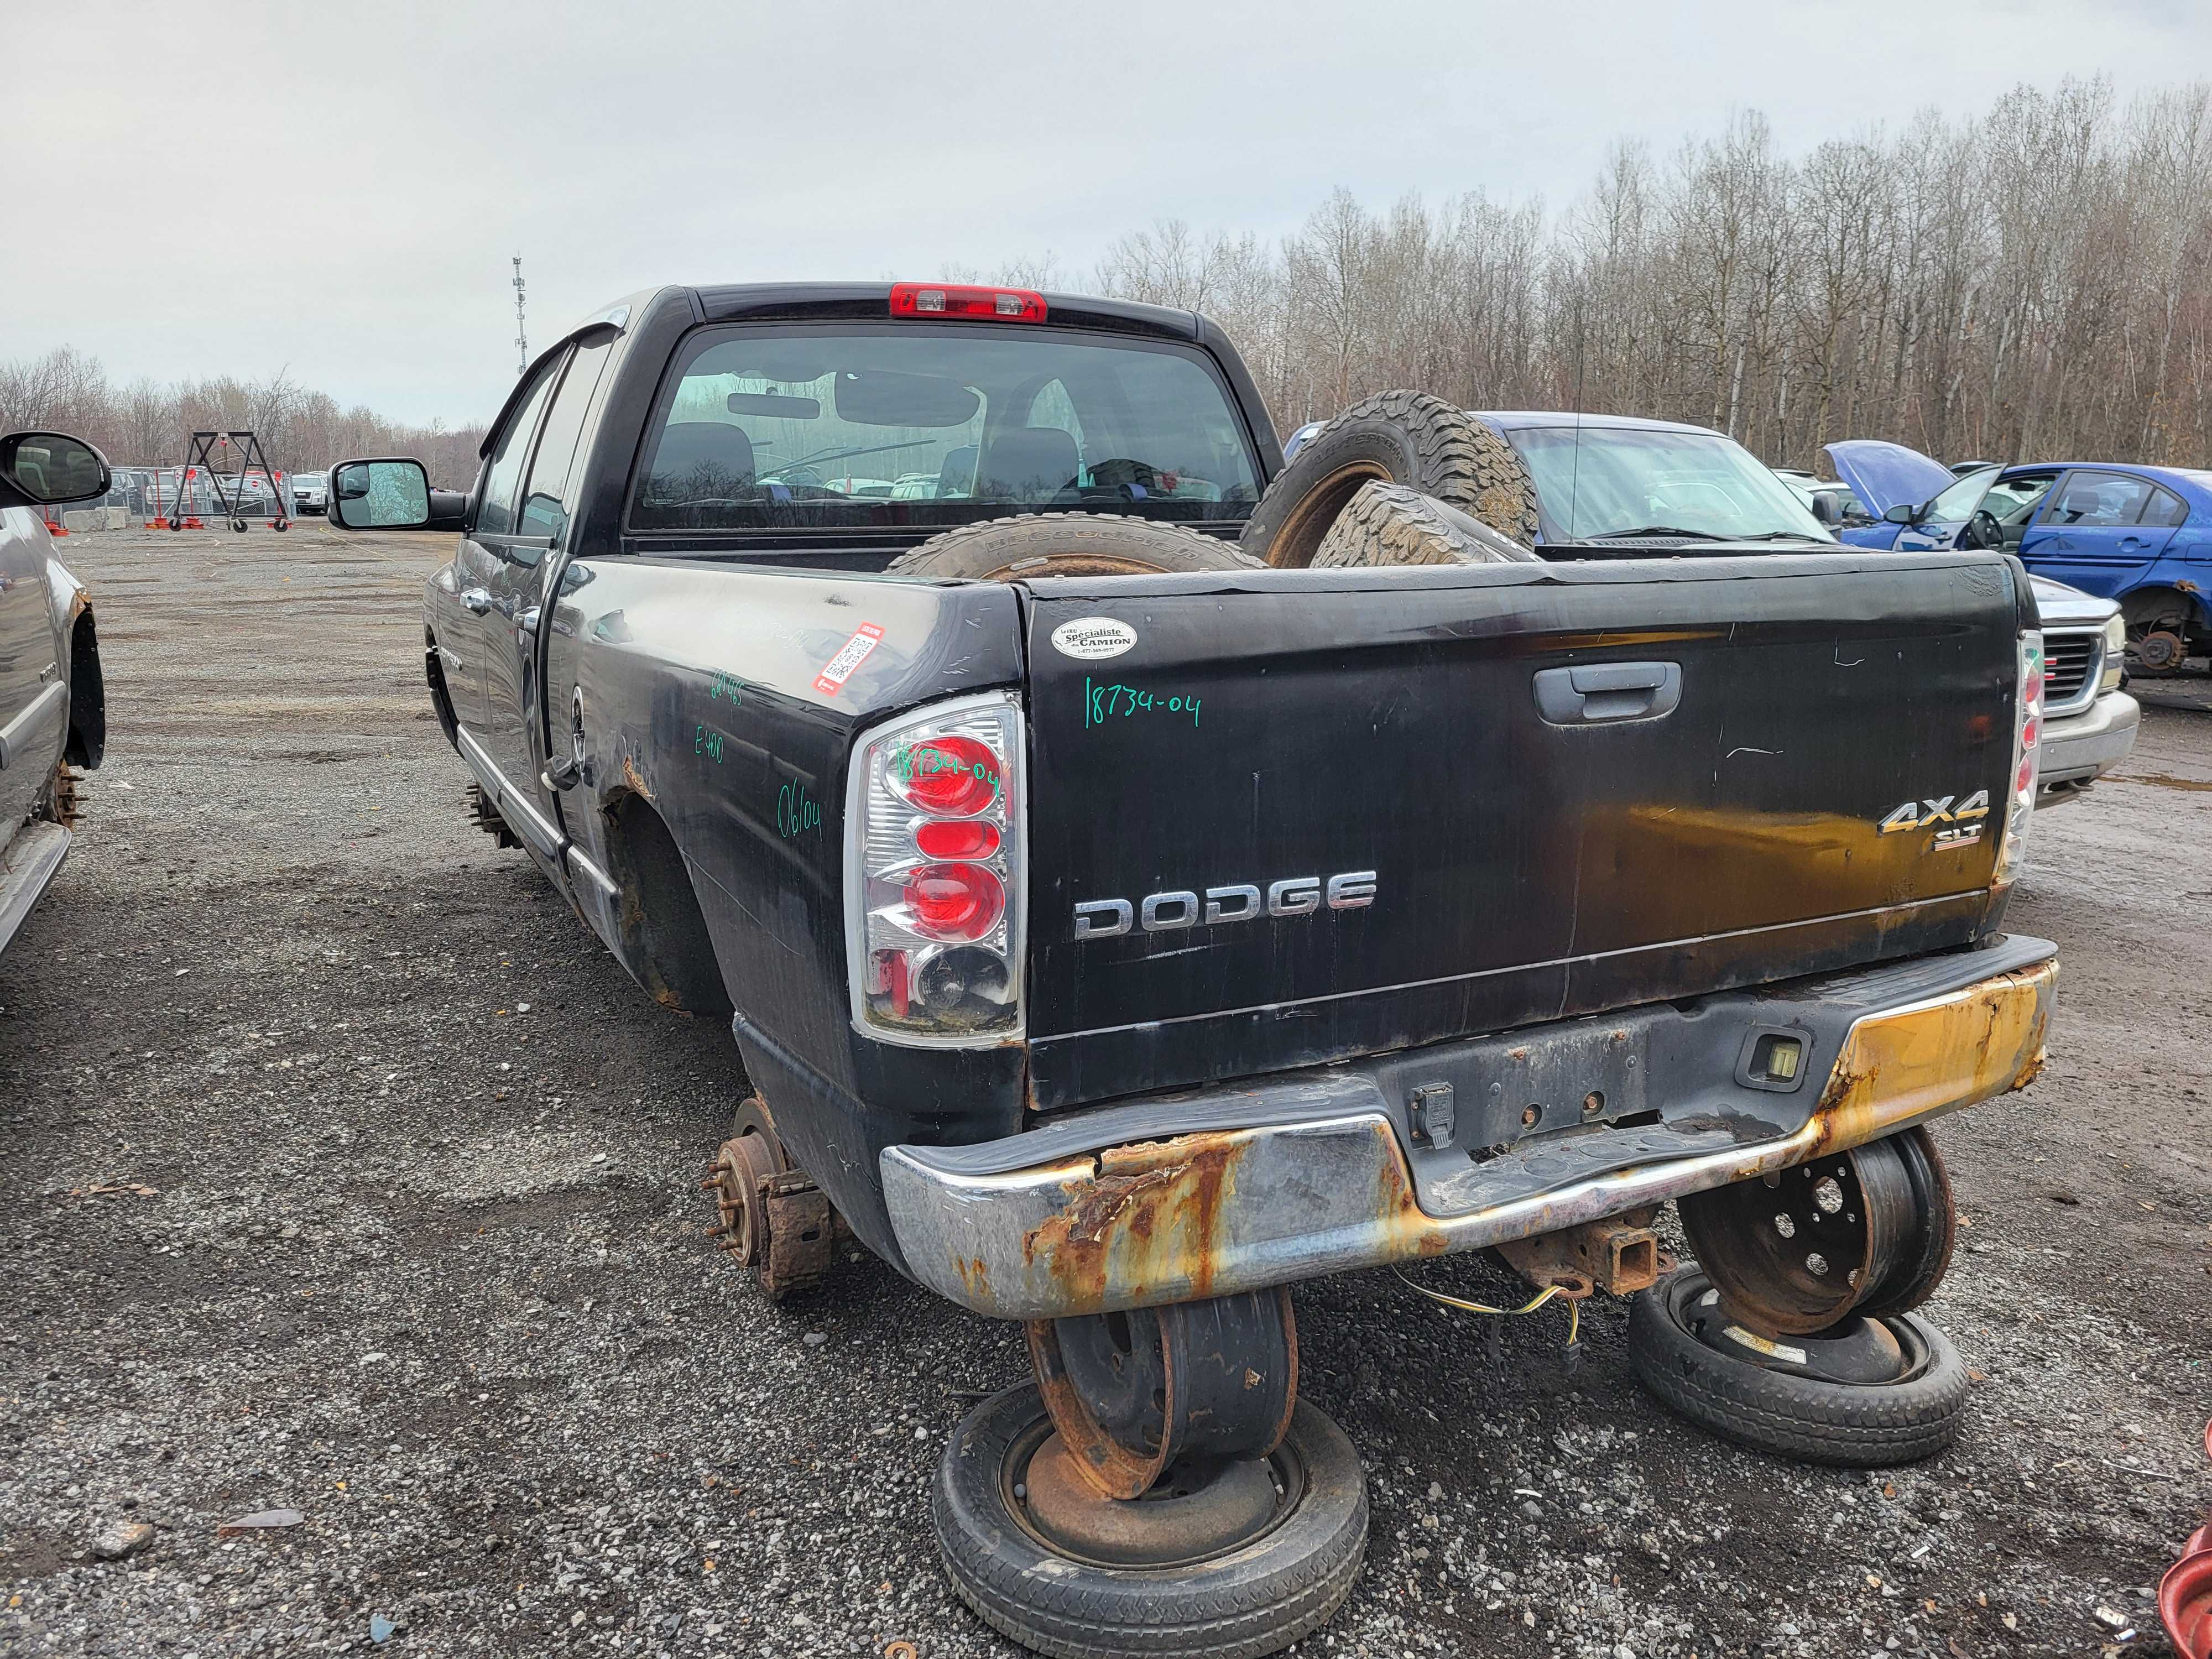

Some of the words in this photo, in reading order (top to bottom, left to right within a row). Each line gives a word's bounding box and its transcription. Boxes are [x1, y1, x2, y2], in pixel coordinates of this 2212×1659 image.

[1079, 638, 1130, 646] CAMION
[1086, 676, 1201, 729] 18734-04
[1936, 824, 1983, 842] SLT
[1074, 870, 1377, 941] DODGE
